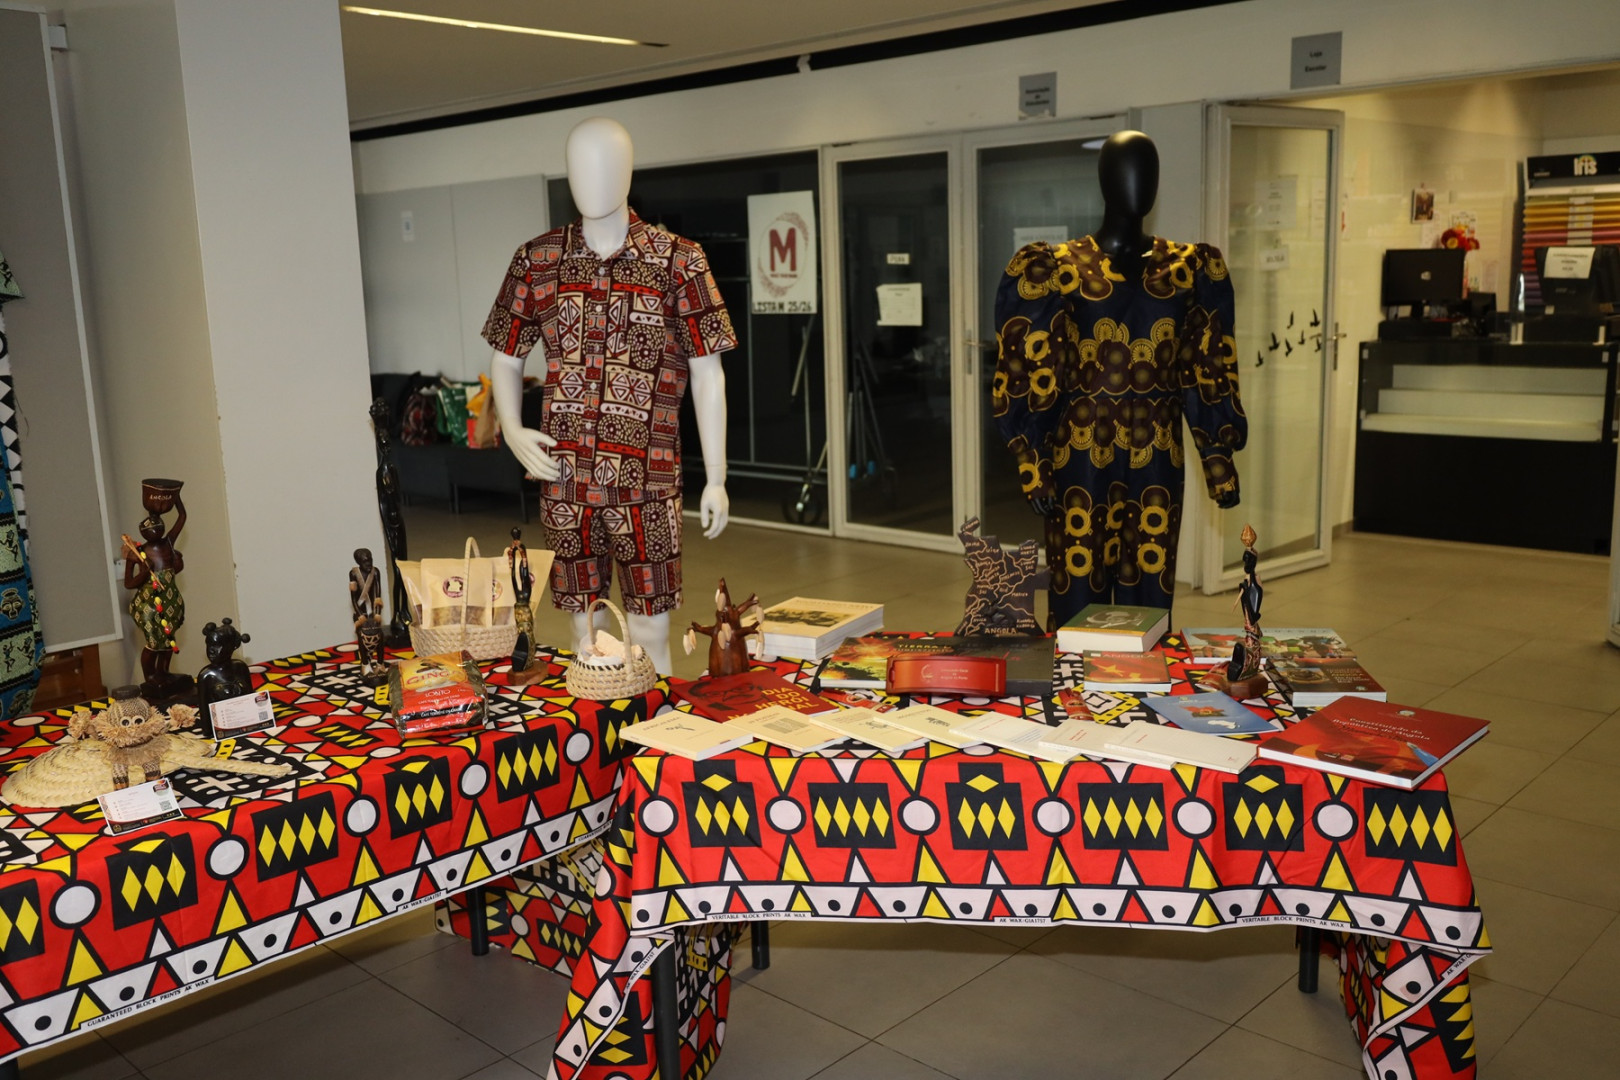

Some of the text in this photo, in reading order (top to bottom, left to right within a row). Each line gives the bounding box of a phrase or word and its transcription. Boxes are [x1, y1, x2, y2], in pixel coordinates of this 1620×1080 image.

[769, 227, 797, 272] M
[753, 301, 776, 313] LISTA
[984, 627, 1017, 635] ANGOLA
[762, 687, 793, 695] DIA
[776, 691, 800, 699] DO
[87, 979, 210, 1027] GUARANTEED BLOCK PRINTS AK WAX
